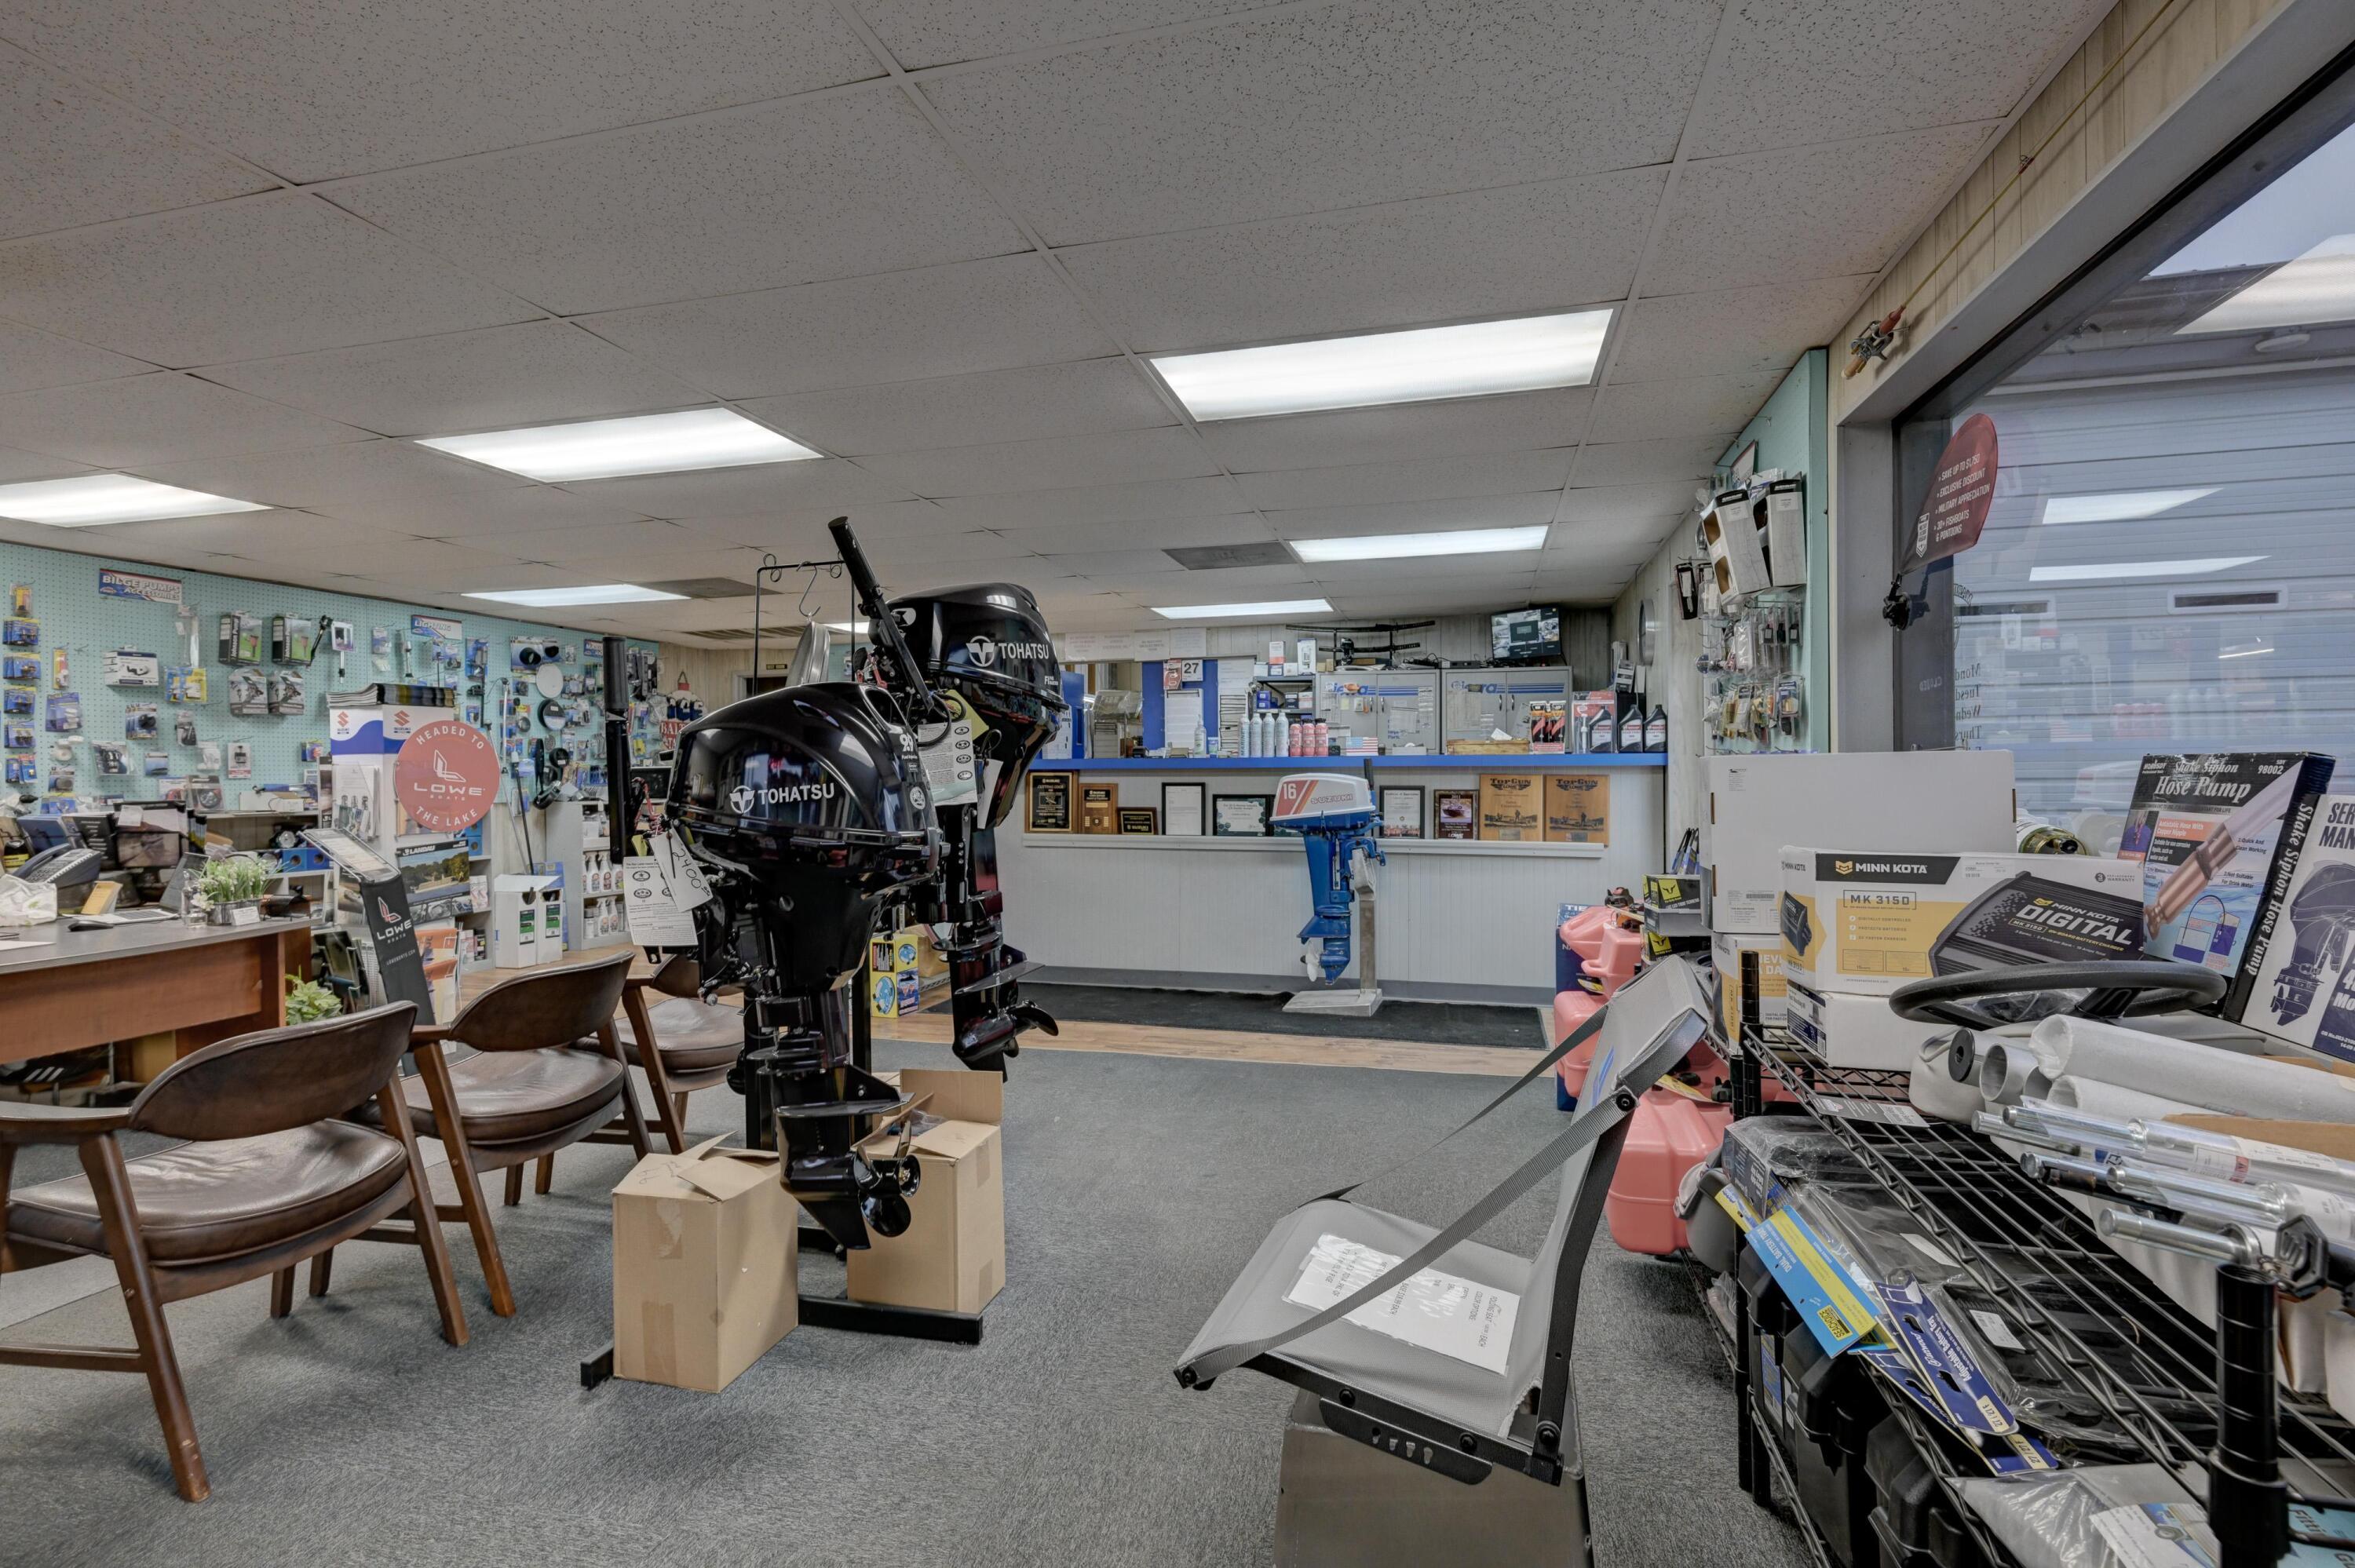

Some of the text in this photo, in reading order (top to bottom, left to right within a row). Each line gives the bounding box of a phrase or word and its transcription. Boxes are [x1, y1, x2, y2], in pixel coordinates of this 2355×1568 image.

[1941, 470, 1952, 481] SAVE
[1952, 465, 1958, 475] UP
[1959, 462, 1966, 472] TO
[1940, 468, 1986, 498] EXCLUSIVE DISCOUNT
[1938, 483, 1991, 514] MILITARY APPRECIATION
[1937, 520, 1945, 531] 30+
[1945, 509, 1970, 527] FISHBOATS
[1940, 524, 1962, 541] PONTOONS
[102, 575, 181, 594] BILGE PUMPS
[123, 587, 181, 600] ACCESSORIES
[414, 620, 451, 632] LIGHTING
[999, 642, 1050, 660] TOHATSU
[1184, 662, 1199, 673] 27
[416, 725, 484, 749] HEADED TO
[2173, 761, 2239, 778] Shake Siphon
[2257, 765, 2284, 775] 98002
[414, 782, 483, 796] LOWE
[758, 782, 834, 805] TOHATSU
[1283, 783, 1297, 800] 16
[1311, 793, 1353, 804] SUZUKI
[2153, 776, 2251, 803] Hose Pump
[415, 806, 477, 826] THE LAKE
[2328, 801, 2355, 825] SER
[2319, 826, 2355, 851] MAN
[409, 845, 436, 855] LANDAU
[1855, 862, 1928, 874] MINN KOTA
[2246, 804, 2313, 976] Shake Siphon Hose Pump
[1850, 894, 1910, 906] MK 315D
[2051, 903, 2121, 924] MINN KOTA
[376, 919, 413, 940] LOWE
[2016, 904, 2133, 946] DIGITAL
[2332, 992, 2355, 1012] Mo
[1763, 1236, 1784, 1259] BATTERY
[1398, 1281, 1409, 1293] BASE
[1473, 1289, 1484, 1304] COLOR
[1388, 1303, 1400, 1316] EACH
[1817, 1307, 1845, 1340] SEACHOICE
[1477, 1334, 1488, 1348] EACH
[1922, 1315, 1976, 1380] Adjustable Battery Tray
